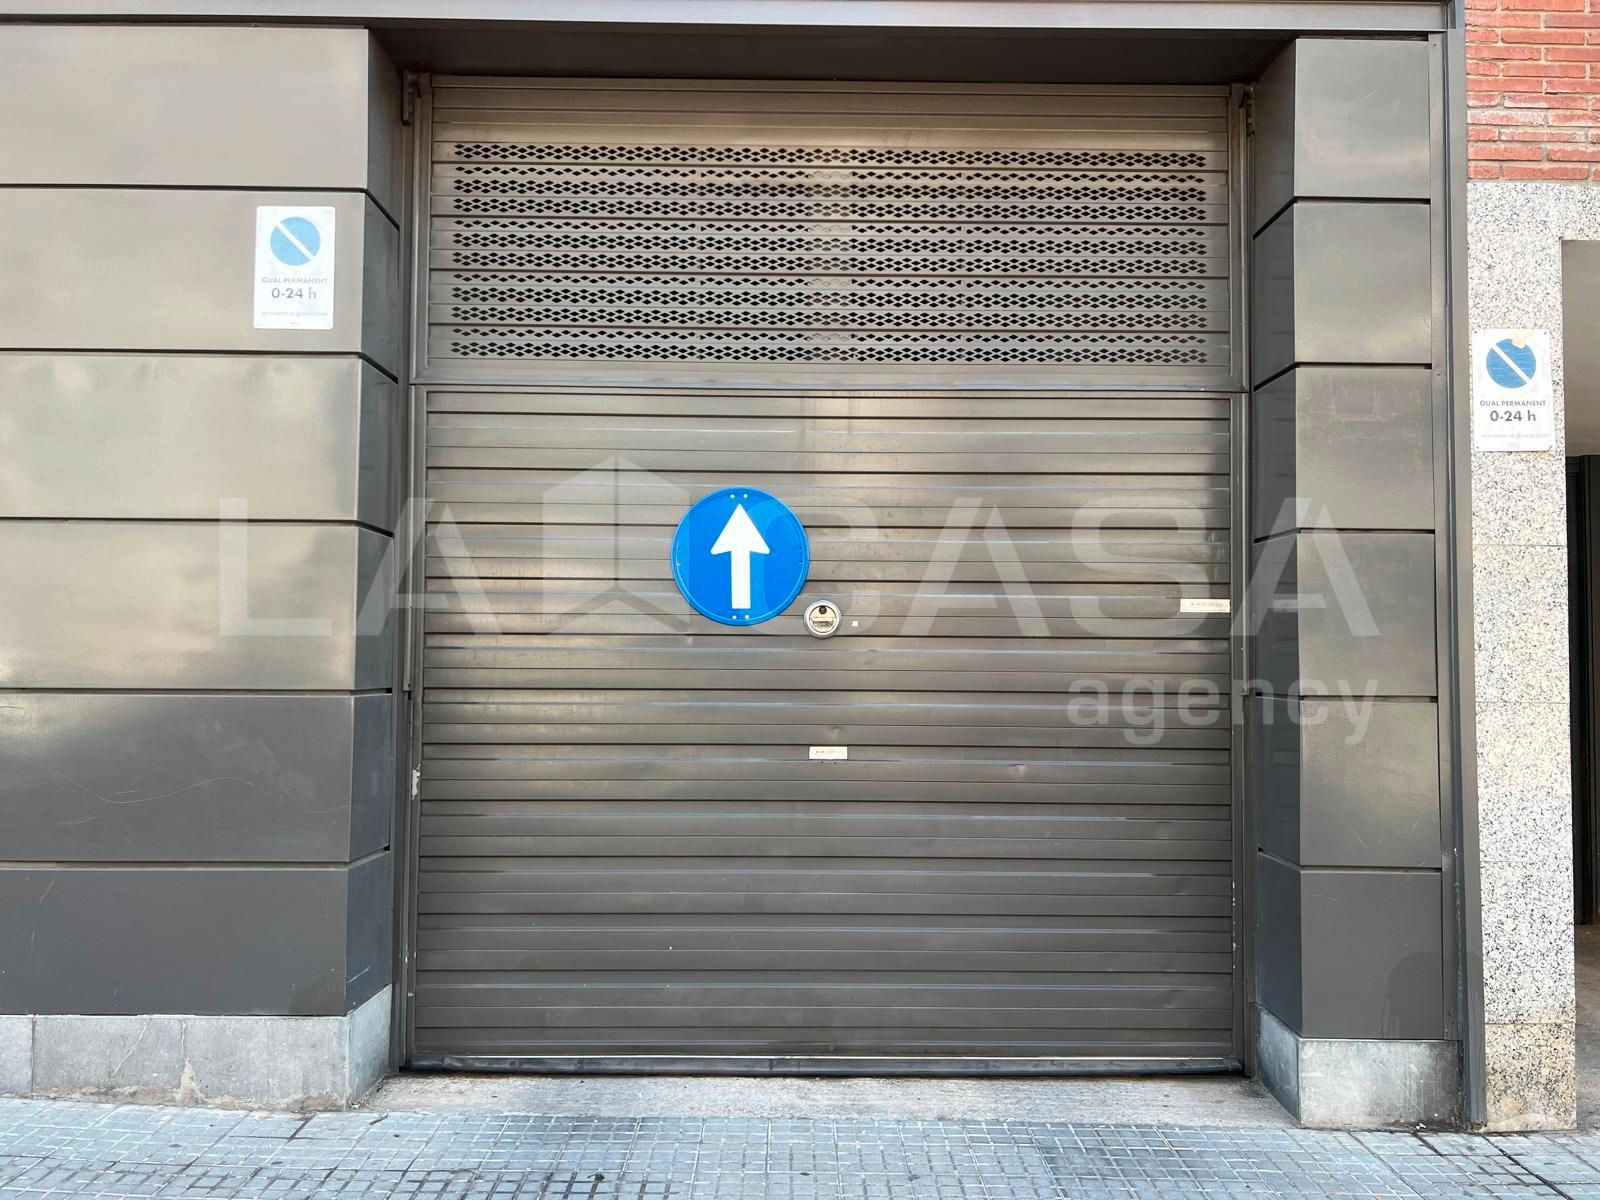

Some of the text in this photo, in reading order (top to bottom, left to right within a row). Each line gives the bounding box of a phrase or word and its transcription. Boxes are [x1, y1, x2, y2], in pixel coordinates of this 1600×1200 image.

[283, 277, 328, 285] PERMANENT
[271, 287, 317, 299] 0-24 h
[1489, 409, 1536, 422] 0-24 h
